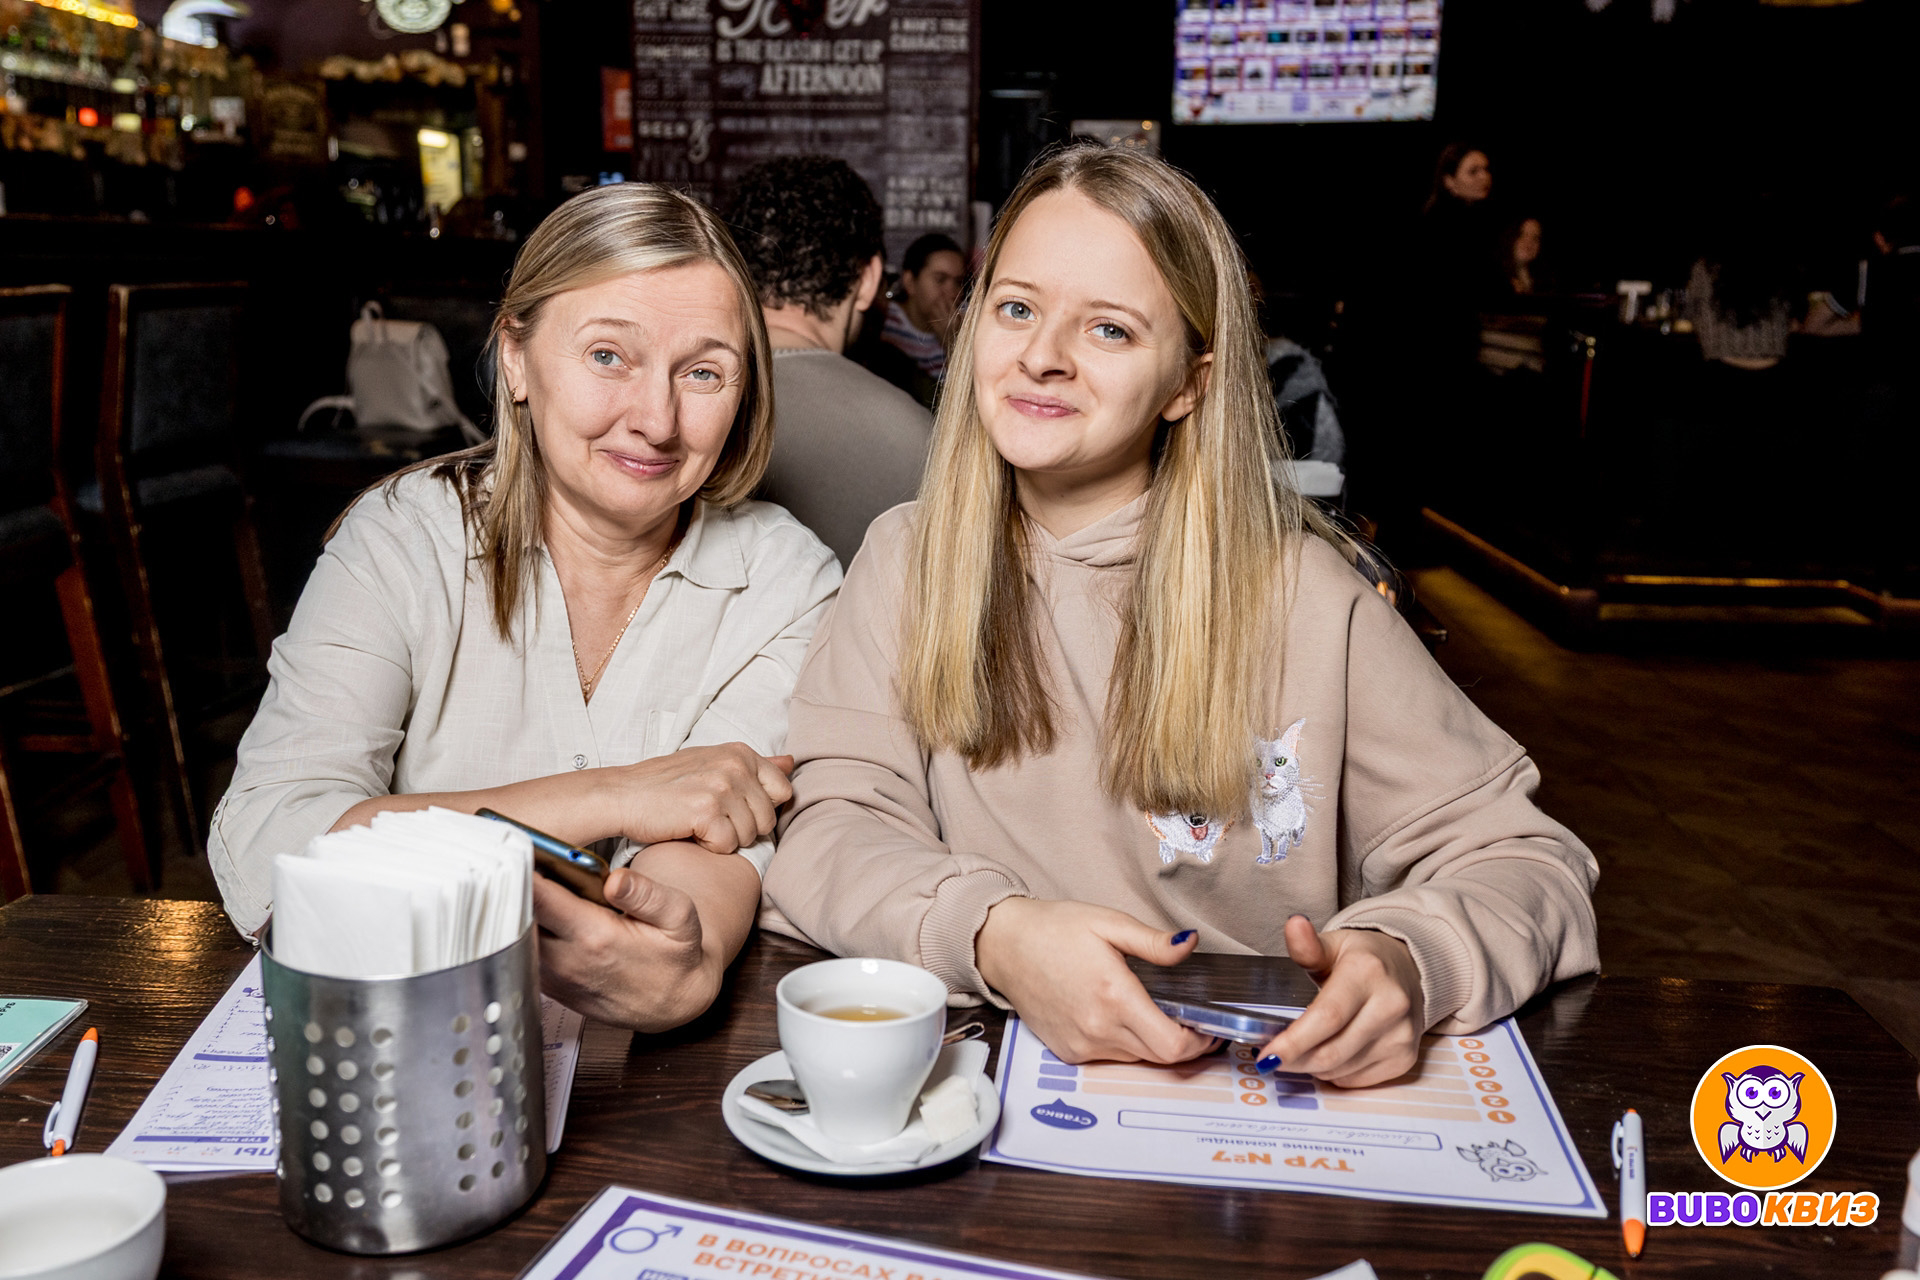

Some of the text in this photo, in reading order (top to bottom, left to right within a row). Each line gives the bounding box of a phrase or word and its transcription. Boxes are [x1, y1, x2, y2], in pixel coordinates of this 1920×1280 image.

[716, 40, 733, 61] IS
[735, 40, 763, 62] THE
[765, 40, 822, 62] REASON
[833, 40, 860, 61] GET
[862, 40, 884, 61] UP
[760, 64, 884, 95] AFTERNOON
[1036, 1107, 1092, 1126] Ставка
[1197, 1136, 1365, 1157] Название команды:
[1284, 1156, 1356, 1172] ТУР
[697, 1233, 896, 1280] В ВОПРОСАХ
